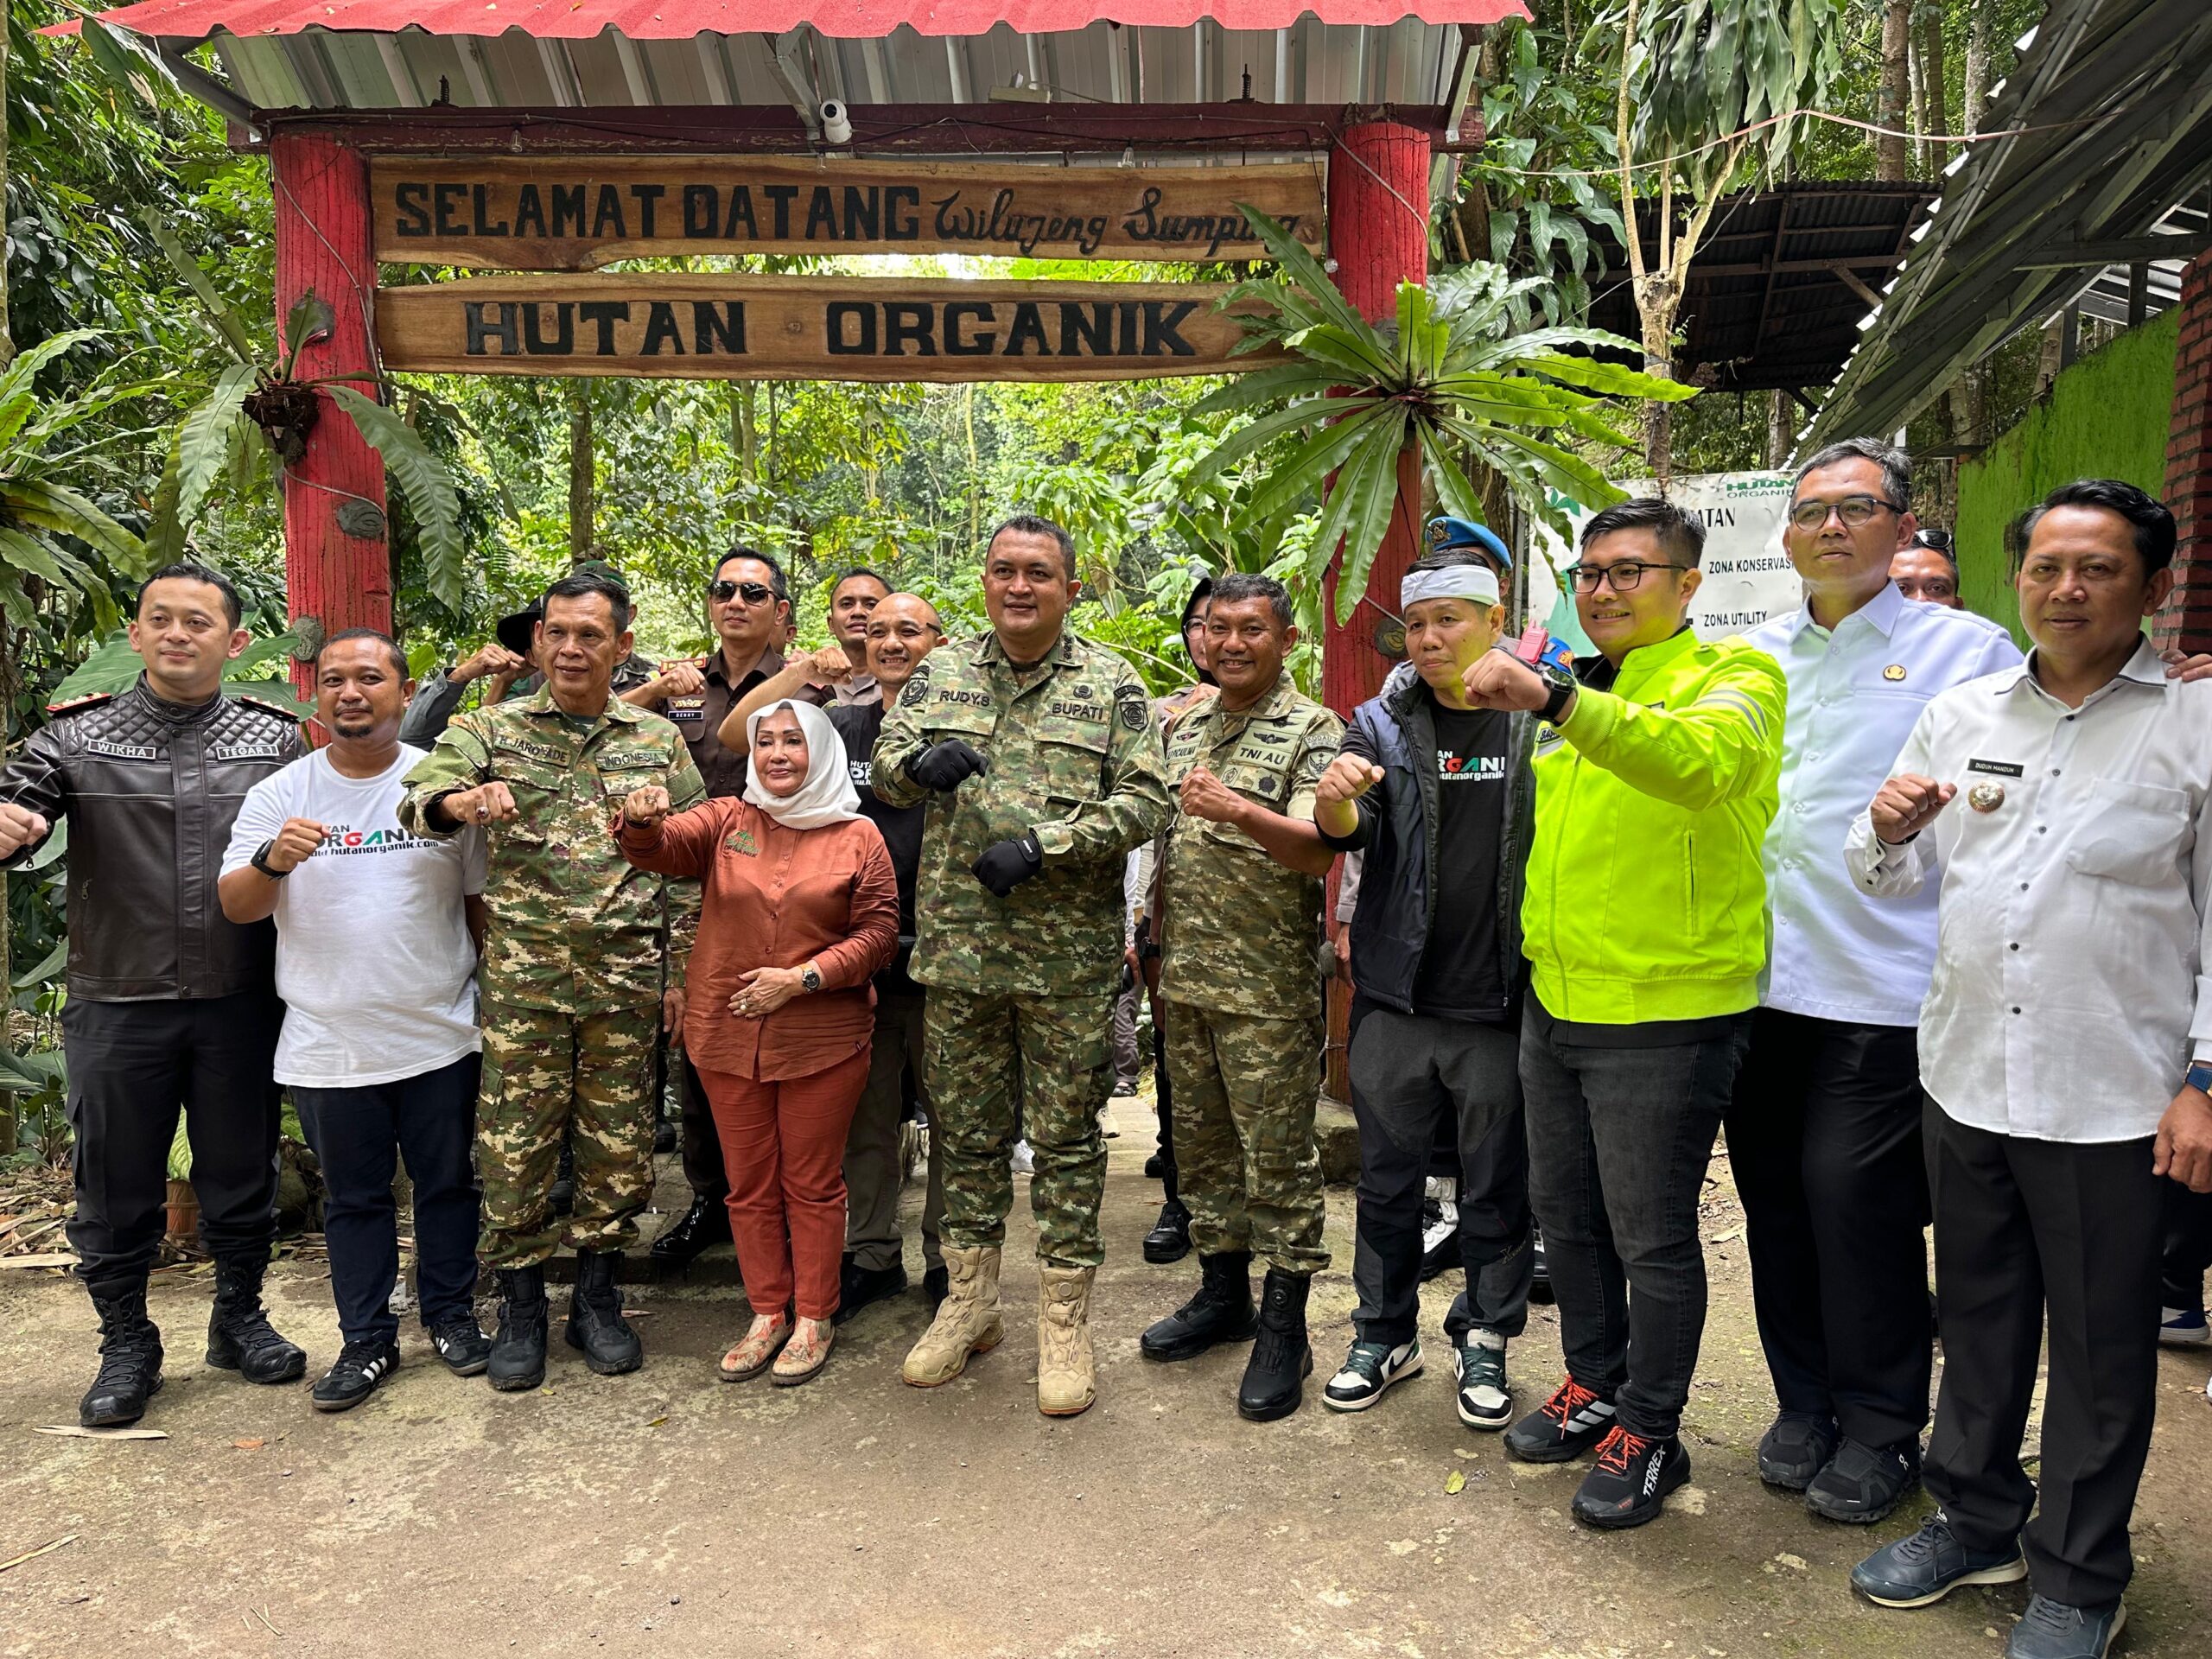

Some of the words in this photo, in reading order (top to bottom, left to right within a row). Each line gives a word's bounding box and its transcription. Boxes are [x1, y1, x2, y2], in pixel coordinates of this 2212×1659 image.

[396, 182, 665, 238] SELAMAT
[683, 184, 919, 240] DATANG
[1122, 187, 1300, 257] Sumpi
[464, 301, 748, 356] HUTAN
[826, 301, 1199, 357] ORGANIK
[1726, 479, 1796, 492] HUTAN
[1709, 560, 1734, 574] ZONA
[1704, 613, 1729, 627] ZONA
[1731, 611, 1767, 626] UTILITY
[939, 690, 990, 707] RUDY.S
[1052, 702, 1103, 721] BUPATI
[98, 742, 147, 757] WIKHA
[222, 747, 264, 757] TEGAR
[1239, 747, 1262, 760] TNI
[1262, 753, 1286, 766] AU
[604, 752, 662, 767] INDONESIA
[849, 760, 872, 769] HUT
[1437, 756, 1506, 772] RGANI
[1439, 770, 1505, 782] utanorganik
[317, 828, 425, 849] RGAN
[1643, 1444, 1667, 1498] TERREX
